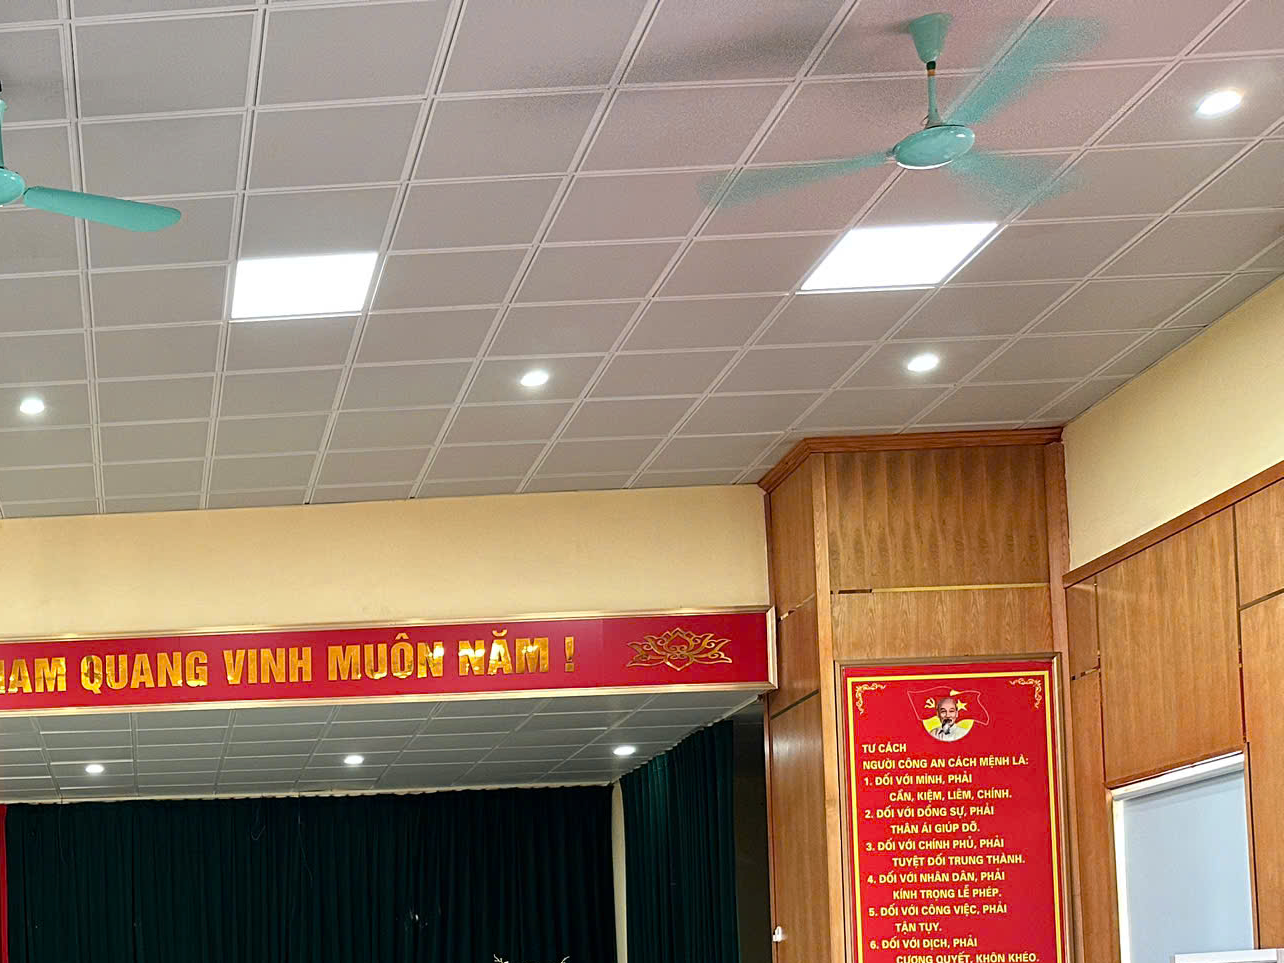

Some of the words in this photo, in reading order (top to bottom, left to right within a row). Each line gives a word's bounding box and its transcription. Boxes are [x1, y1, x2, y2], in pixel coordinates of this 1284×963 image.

[80, 648, 209, 694] QUANG
[222, 646, 310, 685] VINH
[329, 633, 447, 681] MUÔN
[458, 629, 550, 677] NĂM
[564, 636, 575, 673] !
[861, 744, 876, 753] TƯ
[877, 741, 906, 753] CÁCH
[862, 757, 895, 769] NGƯỜI
[897, 756, 927, 768] CÔNG
[929, 759, 945, 768] AN
[947, 755, 976, 767] CÁCH
[979, 755, 1009, 769] MỆNH
[1012, 754, 1028, 766] LÀ:
[864, 777, 872, 786] 1.
[874, 772, 893, 786] ĐỐI
[895, 773, 913, 785] VỚI
[915, 773, 945, 786] MÌNH,
[947, 772, 972, 784] PHẢI
[889, 787, 914, 802] CẦN,
[916, 788, 944, 803] KIỆM,
[947, 788, 974, 801] LIÊM,
[976, 787, 1012, 799] CHÍNH.
[864, 809, 873, 818] 2.
[876, 804, 894, 818] ĐỐI
[896, 806, 914, 817] VỚI
[916, 804, 947, 817] ĐỒNG
[949, 807, 966, 819] SỰ,
[969, 804, 994, 816] PHẢI
[890, 822, 918, 834] THÂN
[921, 822, 932, 834] ÁI
[934, 821, 959, 833] GIÚP
[961, 821, 980, 833] ĐỠ.
[866, 842, 875, 851] 3.
[877, 838, 896, 851] ĐỐI
[898, 838, 916, 850] VỚI
[918, 838, 950, 850] CHÍNH
[952, 837, 976, 850] PHỦ,
[979, 836, 1004, 848] PHẢI
[892, 855, 924, 869] TUYỆT
[927, 852, 946, 866] ĐỐI
[947, 856, 984, 865] TRUNG
[985, 852, 1025, 864] THÀNH.
[867, 874, 876, 883] 4.
[878, 870, 896, 883] ĐỐI
[899, 871, 917, 882] VỚI
[919, 870, 949, 882] NHÂN
[951, 870, 977, 883] DÂN,
[980, 869, 1004, 881] PHẢI
[892, 887, 917, 899] KÍNH
[919, 889, 955, 901] TRỌNG
[957, 885, 969, 898] LỄ
[972, 886, 1001, 898] PHÉP.
[868, 908, 878, 917] 5.
[880, 903, 898, 916] ĐỐI
[900, 904, 918, 916] VỚI
[921, 904, 951, 915] CÔNG
[953, 903, 979, 918] VIỆC,
[982, 902, 1007, 914] PHẢI
[894, 921, 916, 935] TẬN
[918, 923, 942, 935] TỤY.
[869, 940, 879, 949] 6.
[881, 936, 900, 949] ĐỐI
[901, 936, 920, 948] VỚI
[922, 939, 950, 951] ĐỊCH,
[952, 936, 977, 947] PHẢI
[975, 952, 1005, 963] KHÔN
[1008, 951, 1039, 963] KHÉO.
